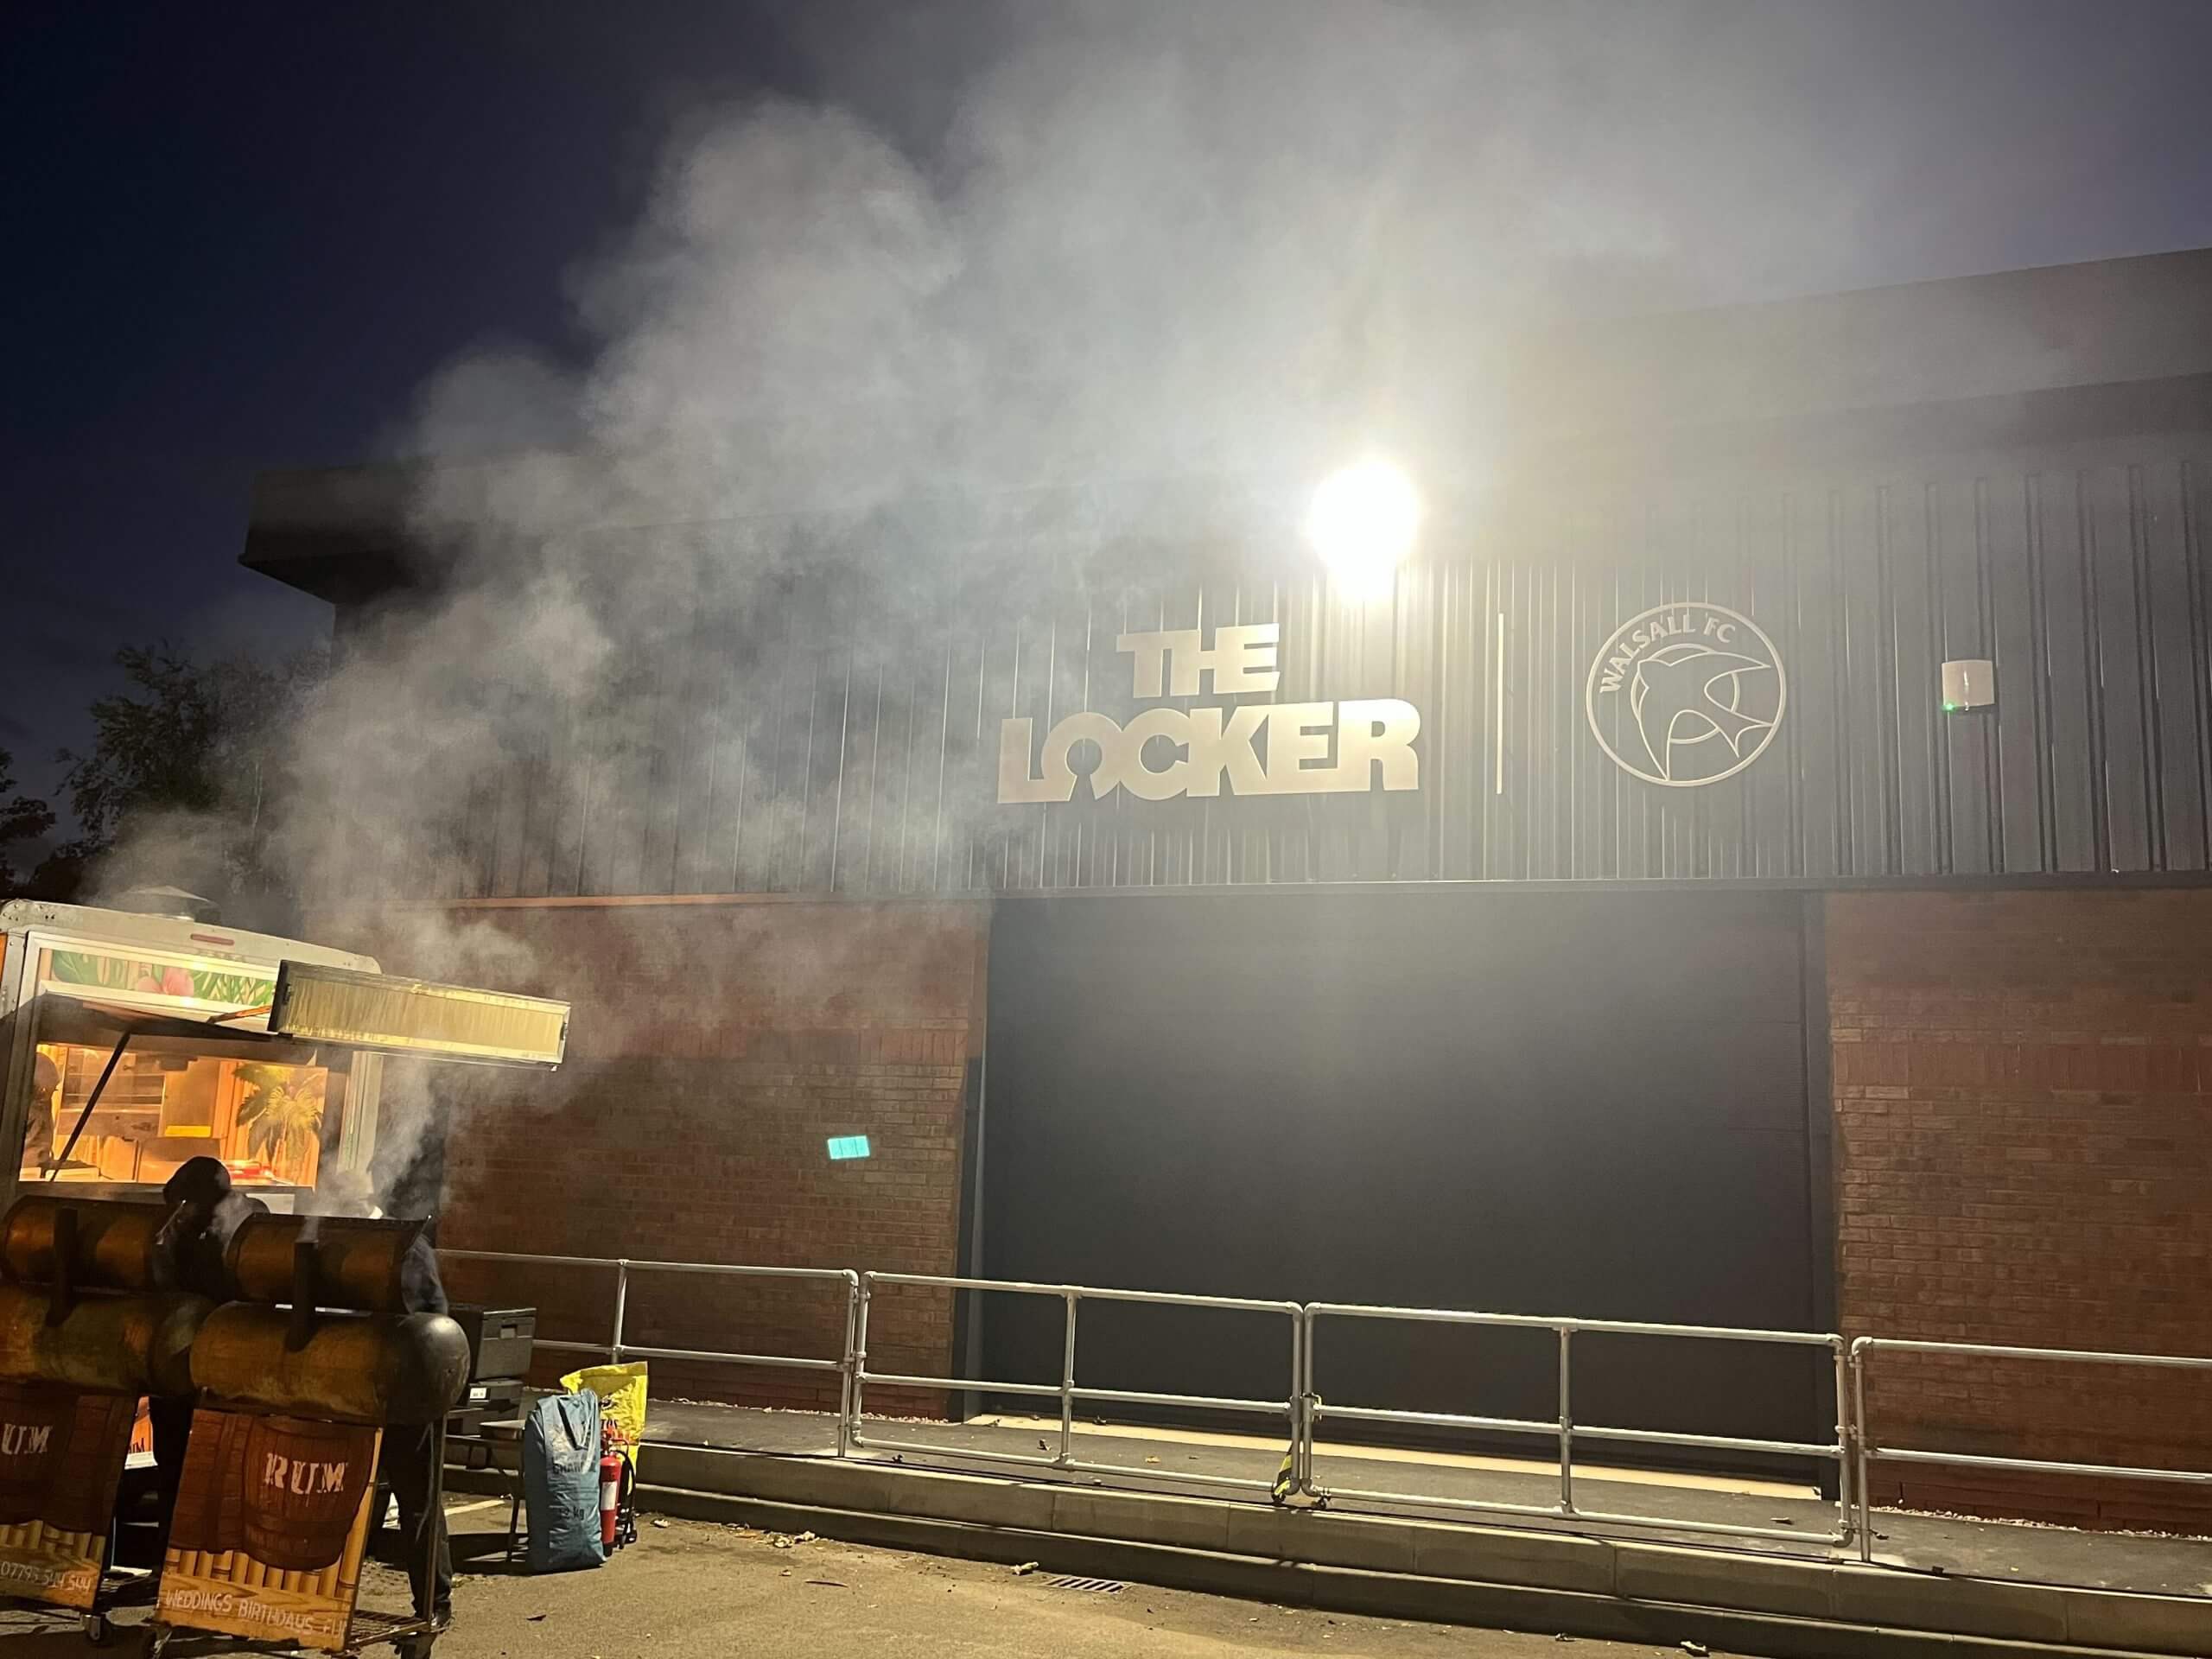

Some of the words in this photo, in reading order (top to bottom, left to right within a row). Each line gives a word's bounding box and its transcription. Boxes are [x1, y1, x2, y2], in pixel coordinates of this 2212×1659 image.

[1116, 622, 1281, 698] THE
[1599, 614, 1696, 693] WALSALL
[1703, 617, 1736, 643] FC
[997, 698, 1421, 804] LOCKER
[264, 1452, 348, 1495] RUM
[165, 1589, 232, 1613] WEDDINGS
[238, 1599, 315, 1634] BIRTHDAYS
